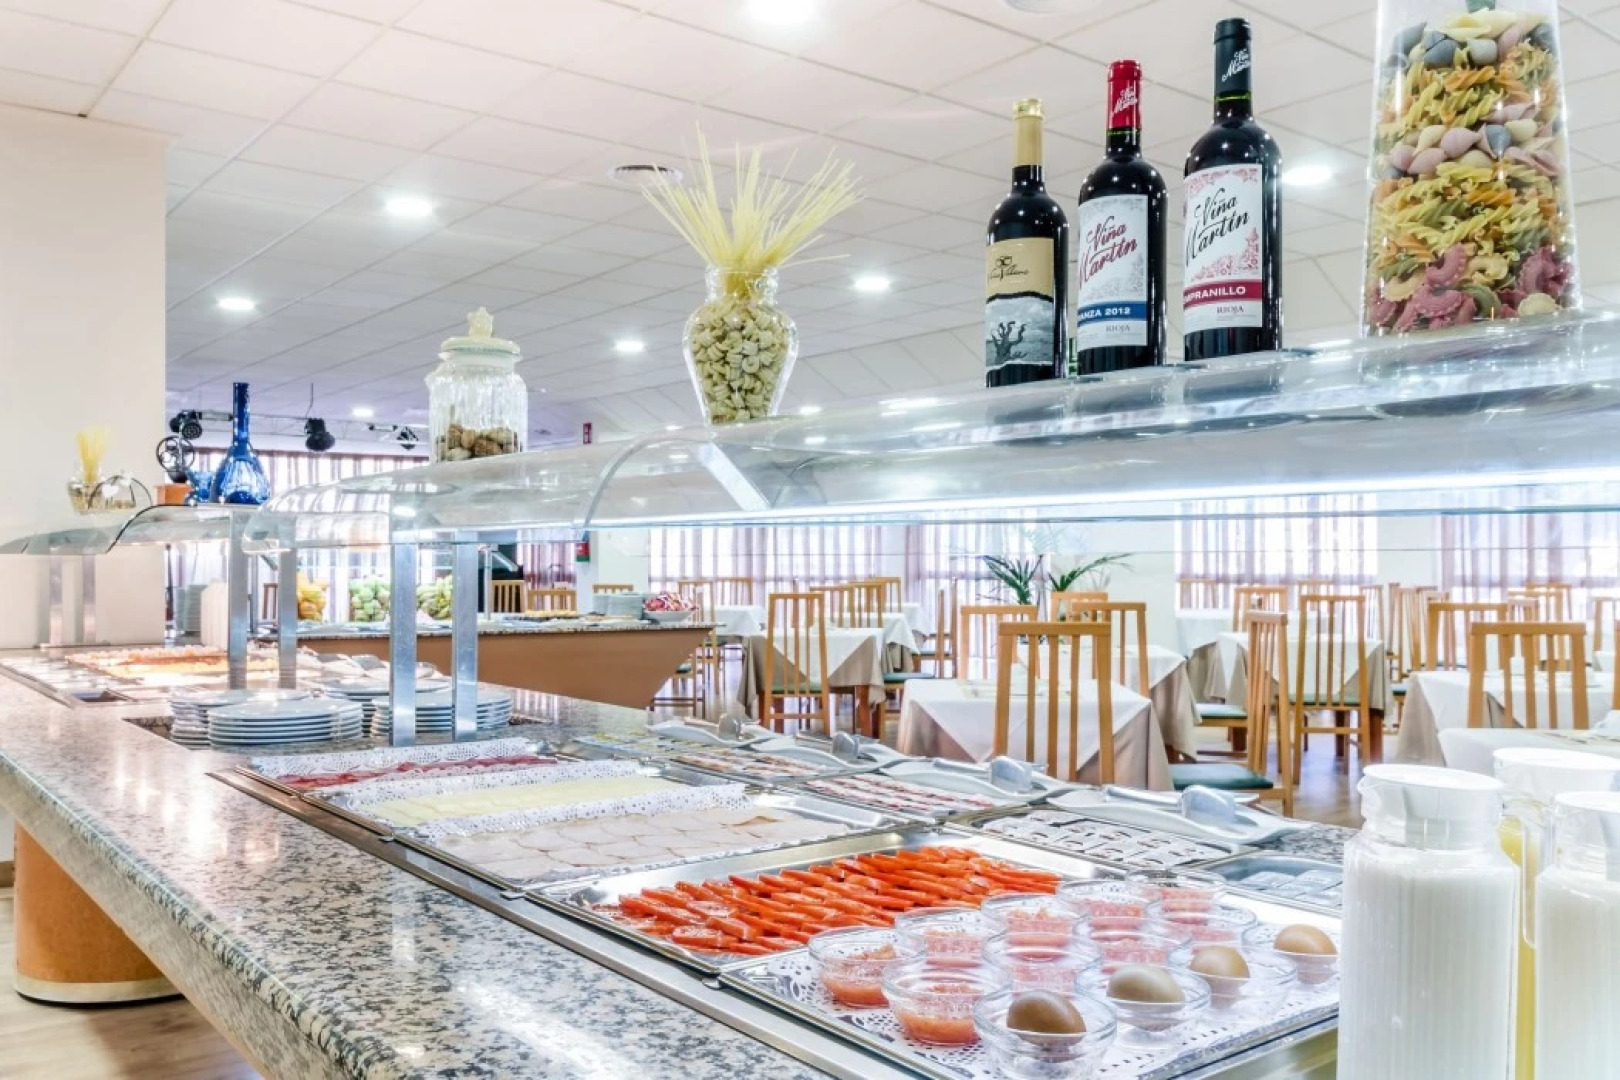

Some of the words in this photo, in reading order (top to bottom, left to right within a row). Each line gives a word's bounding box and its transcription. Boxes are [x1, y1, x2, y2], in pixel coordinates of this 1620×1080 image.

[1194, 187, 1237, 226] Viña
[1086, 215, 1127, 251] Viña
[1184, 286, 1246, 302] MPRANILLO
[1105, 307, 1131, 316] 2012
[1216, 306, 1244, 315] RIOJA
[1106, 325, 1130, 333] RIOJA
